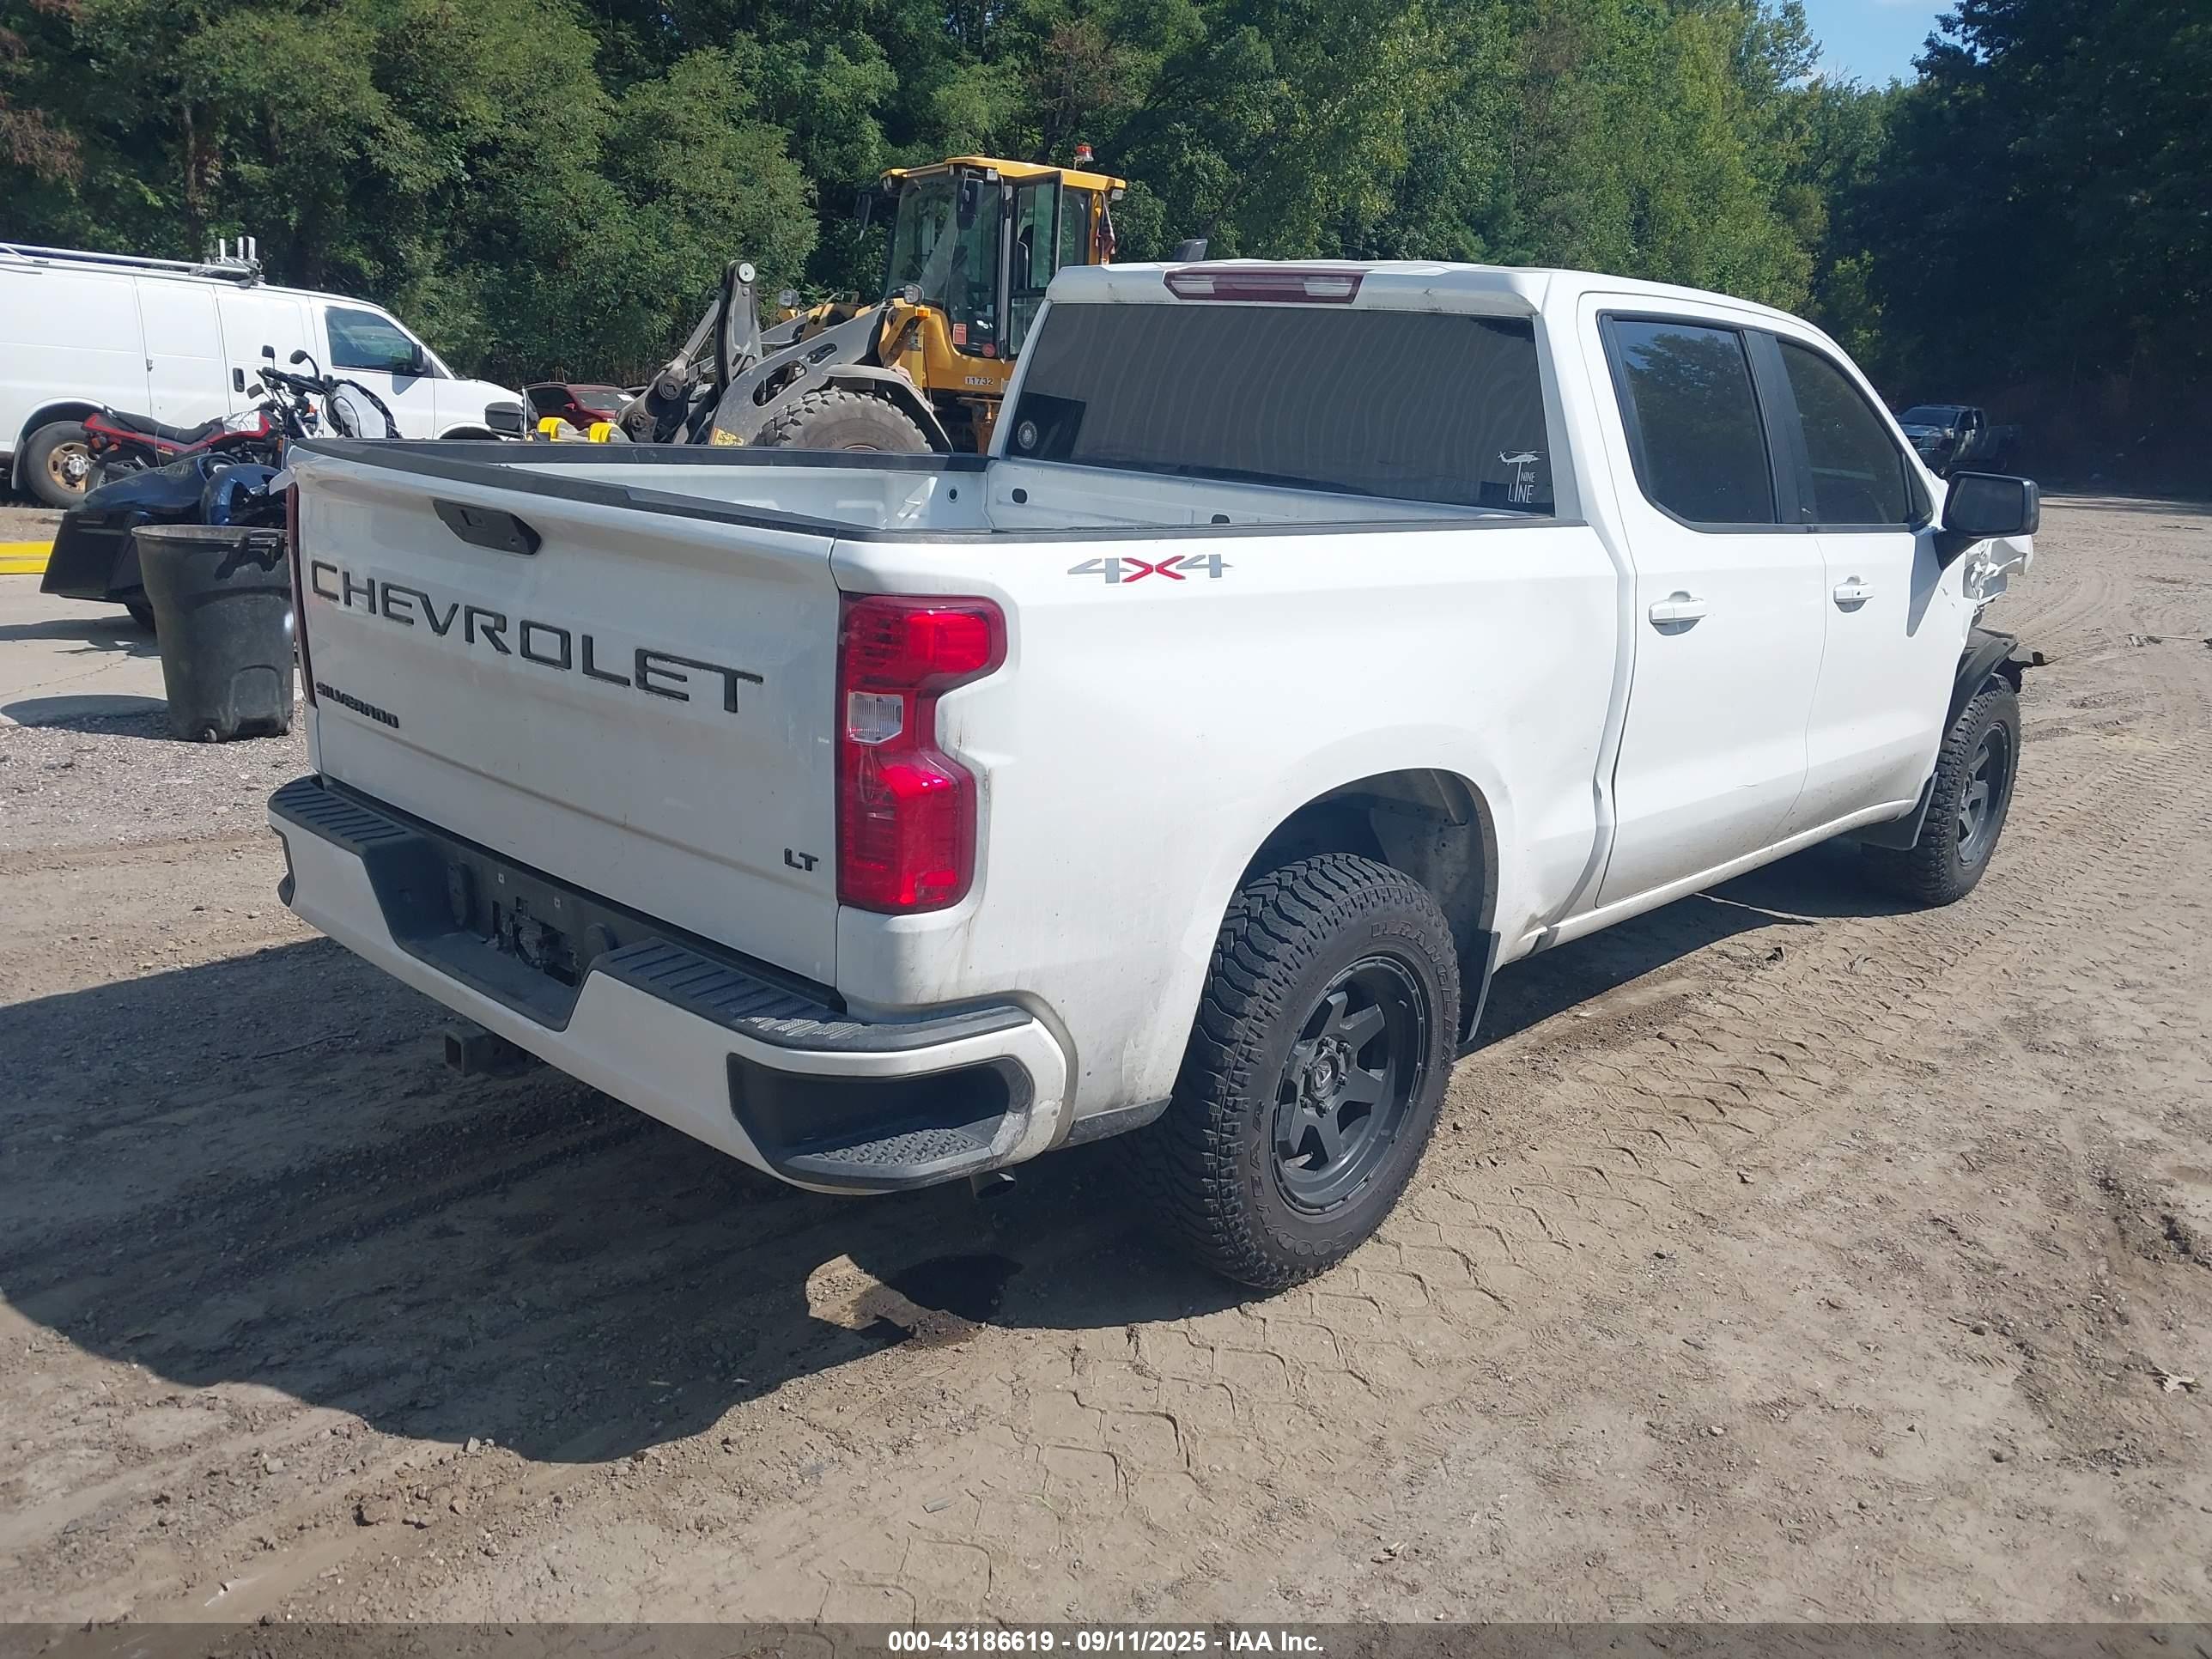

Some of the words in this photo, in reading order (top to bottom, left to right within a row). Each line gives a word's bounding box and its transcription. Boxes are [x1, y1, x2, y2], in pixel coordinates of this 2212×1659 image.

[1507, 482, 1535, 504] LINE
[1520, 471, 1536, 483] NINE
[1067, 554, 1233, 584] 4X4
[310, 559, 763, 714] CHEVROLET
[315, 681, 399, 729] SILVERADO
[783, 847, 819, 872] LT
[1370, 920, 1454, 1073] WRANGLER
[1249, 1099, 1354, 1257] GOODYEAR
